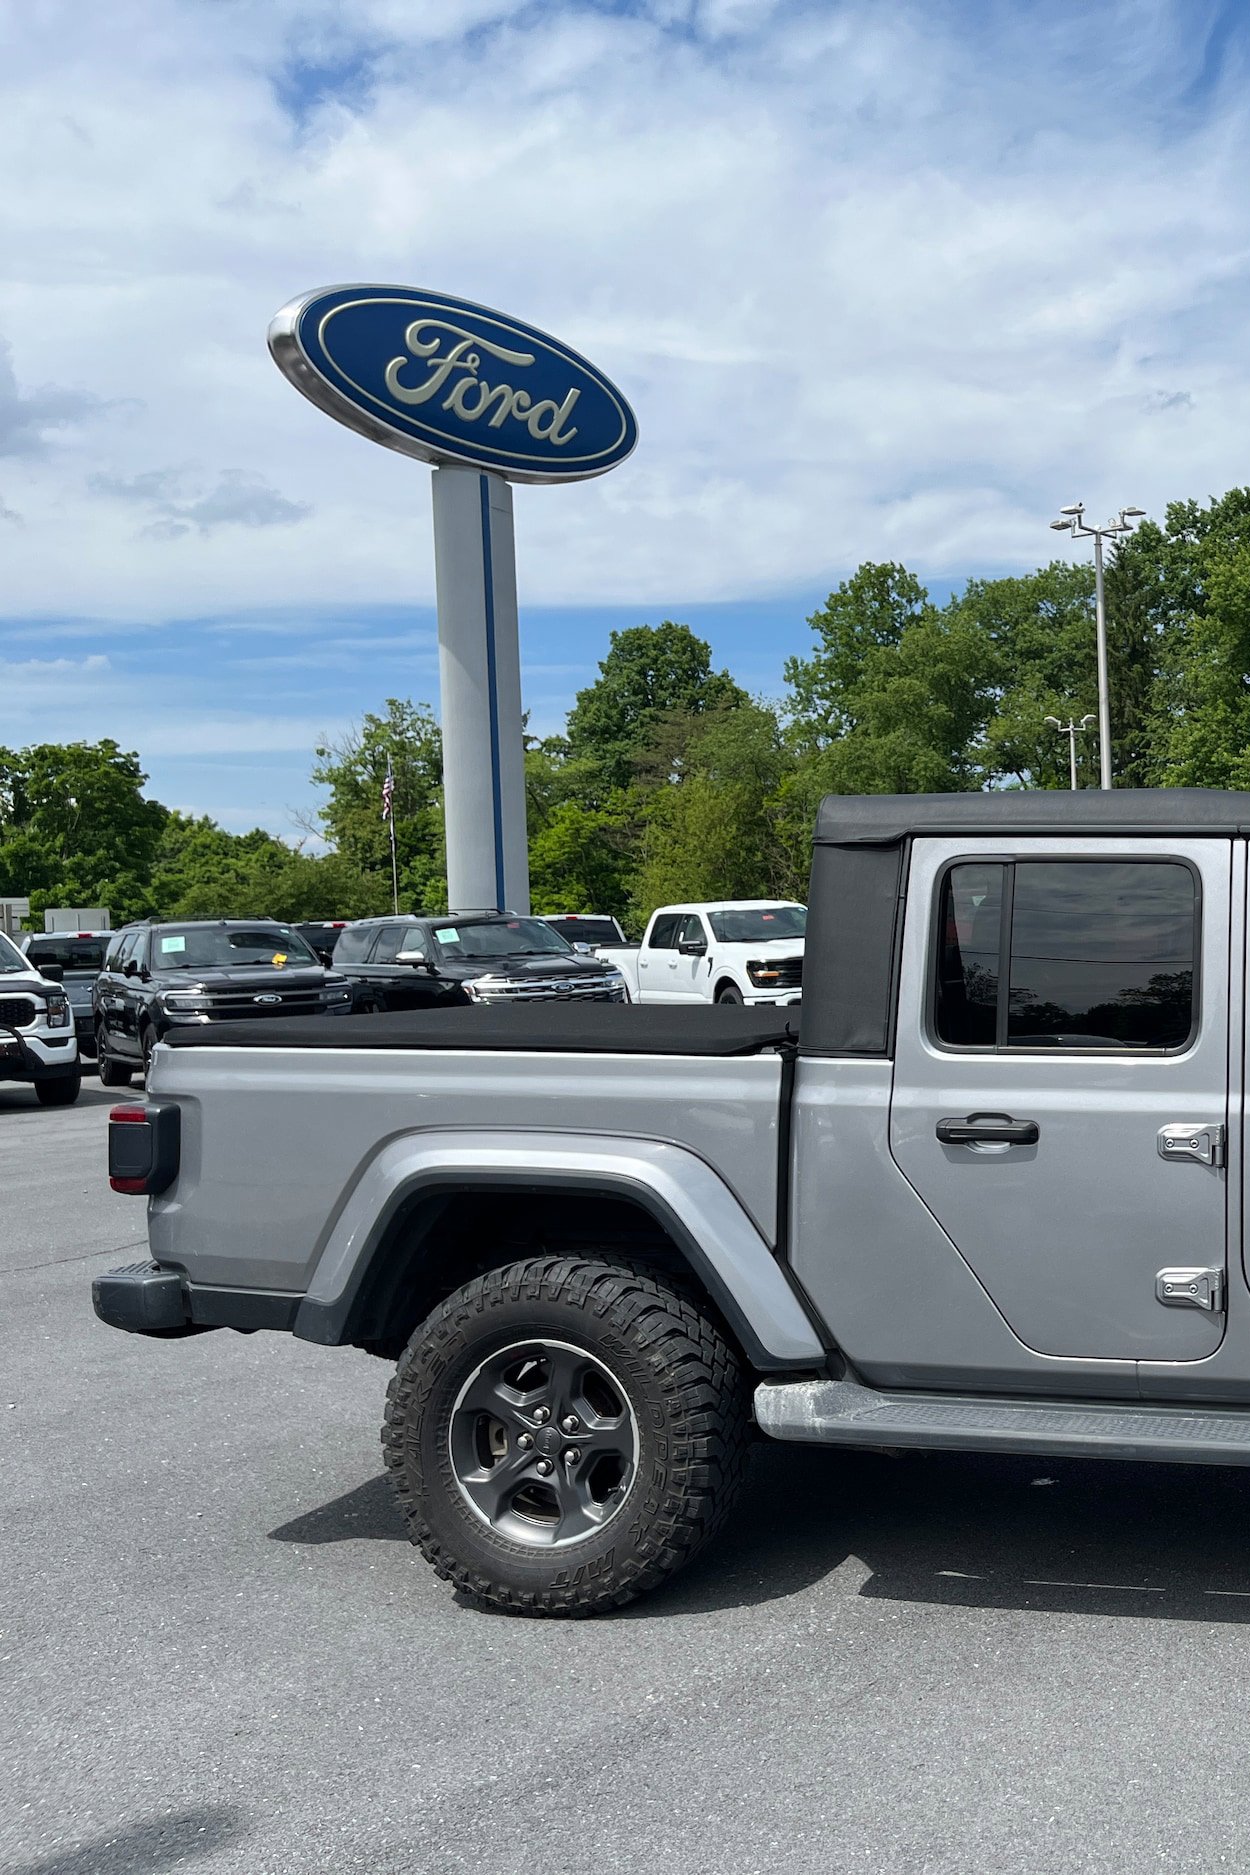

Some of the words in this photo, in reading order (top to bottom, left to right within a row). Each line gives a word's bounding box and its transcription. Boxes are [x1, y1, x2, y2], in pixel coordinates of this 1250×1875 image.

[385, 319, 581, 446] Ford
[405, 1329, 468, 1498] FALKEN
[598, 1333, 669, 1546] WILDPEAK
[550, 1547, 615, 1589] M/T
